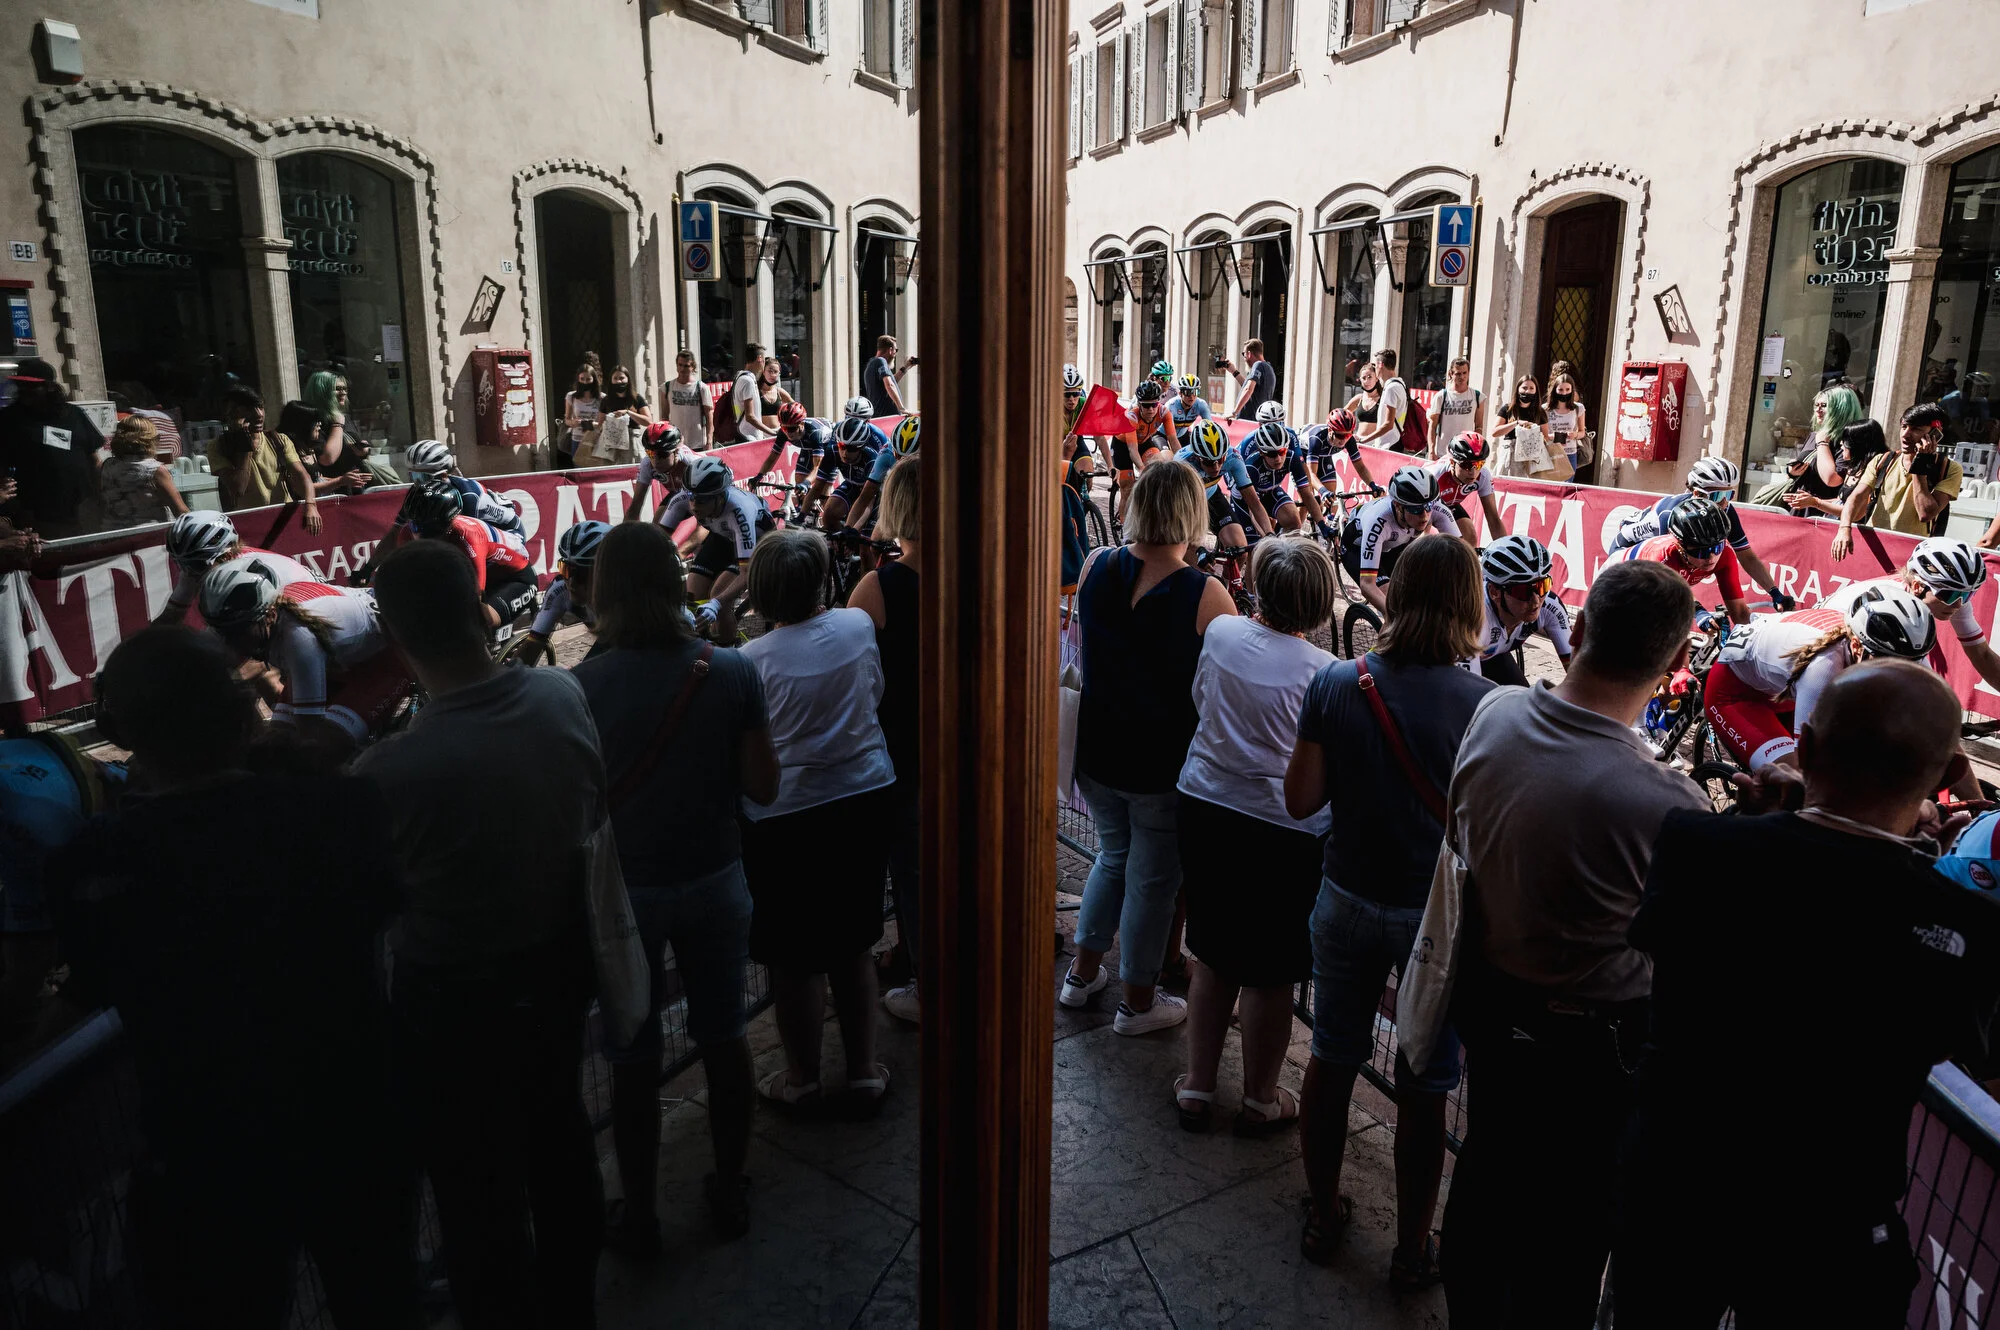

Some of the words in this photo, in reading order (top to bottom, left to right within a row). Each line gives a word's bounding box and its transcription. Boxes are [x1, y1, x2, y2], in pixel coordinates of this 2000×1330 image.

[1813, 233, 1893, 271] tiger
[1648, 269, 1656, 280] 87
[1834, 310, 1866, 319] online?
[1444, 399, 1473, 407] VACAY
[1443, 406, 1473, 415] TIMES
[1633, 522, 1654, 539] FRANCE
[1709, 705, 1748, 751] POLSKA
